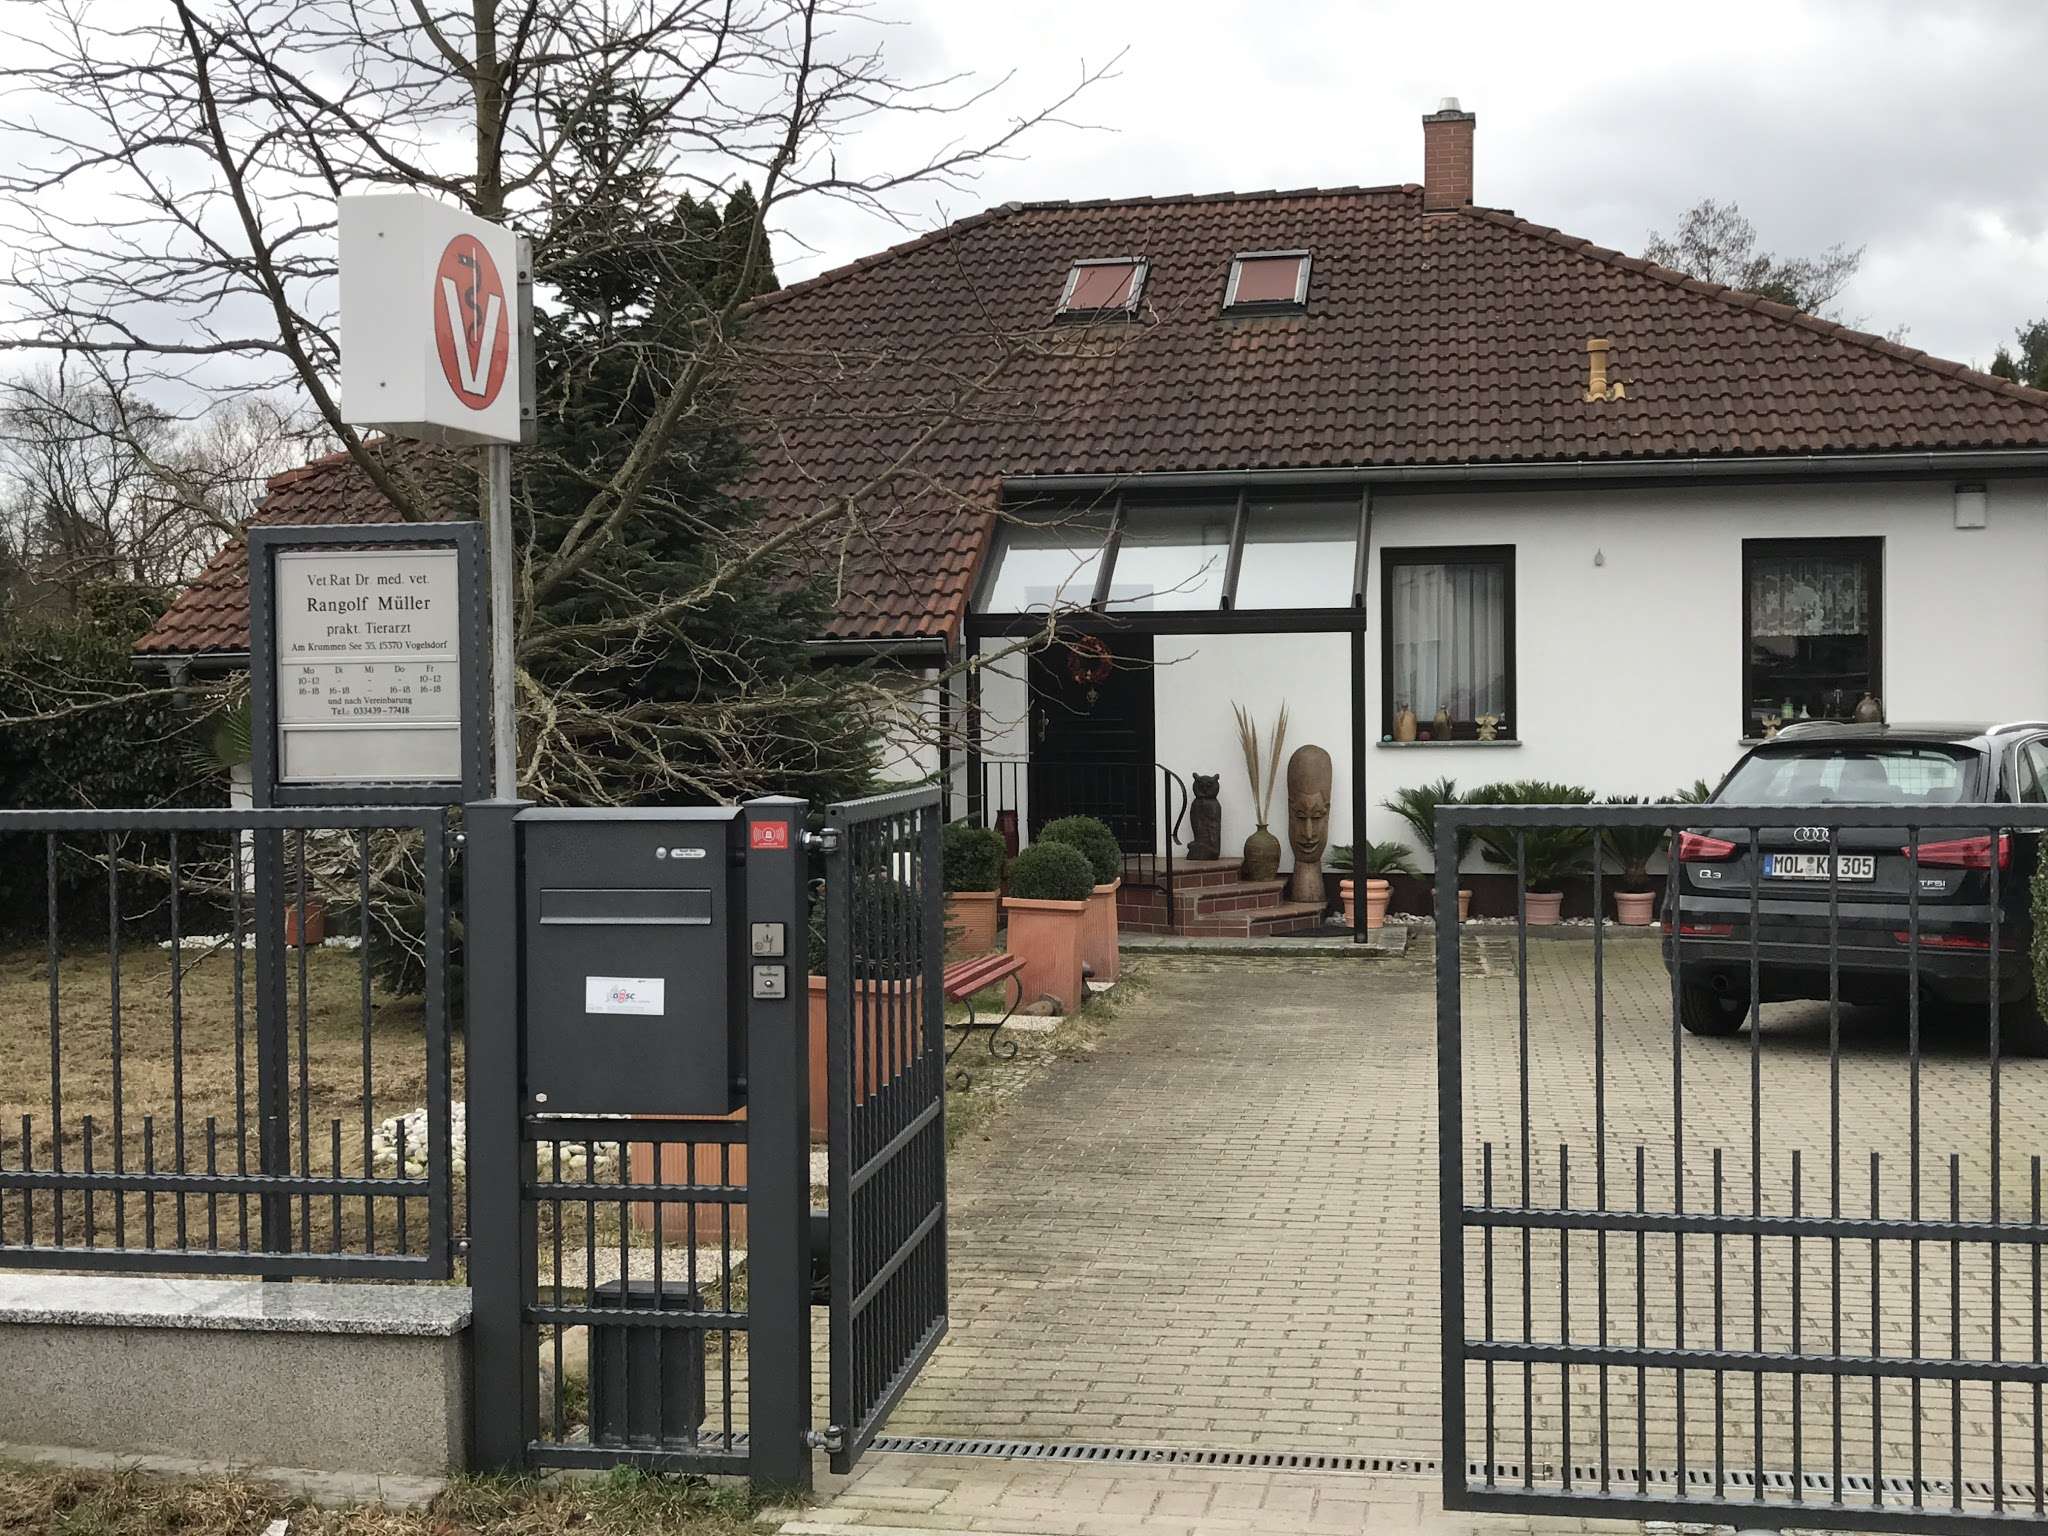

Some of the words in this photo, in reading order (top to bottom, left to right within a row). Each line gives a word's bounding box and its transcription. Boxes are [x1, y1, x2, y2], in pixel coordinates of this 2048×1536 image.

[441, 276, 501, 398] V
[307, 596, 369, 614] Rangolf
[378, 595, 431, 611] Müller
[365, 622, 411, 634] Tierarzt
[292, 644, 305, 652] Am
[308, 643, 346, 652] Krummen
[349, 642, 362, 650] See
[379, 641, 403, 650] 15370
[405, 640, 448, 651] Vogelsdorf
[394, 665, 405, 673] Do
[328, 697, 342, 705] und
[344, 697, 361, 705] nach
[364, 696, 412, 705] Vereinbarung
[1773, 855, 1803, 874] MOL
[1841, 857, 1872, 875] 305
[1699, 868, 1722, 879] Q3
